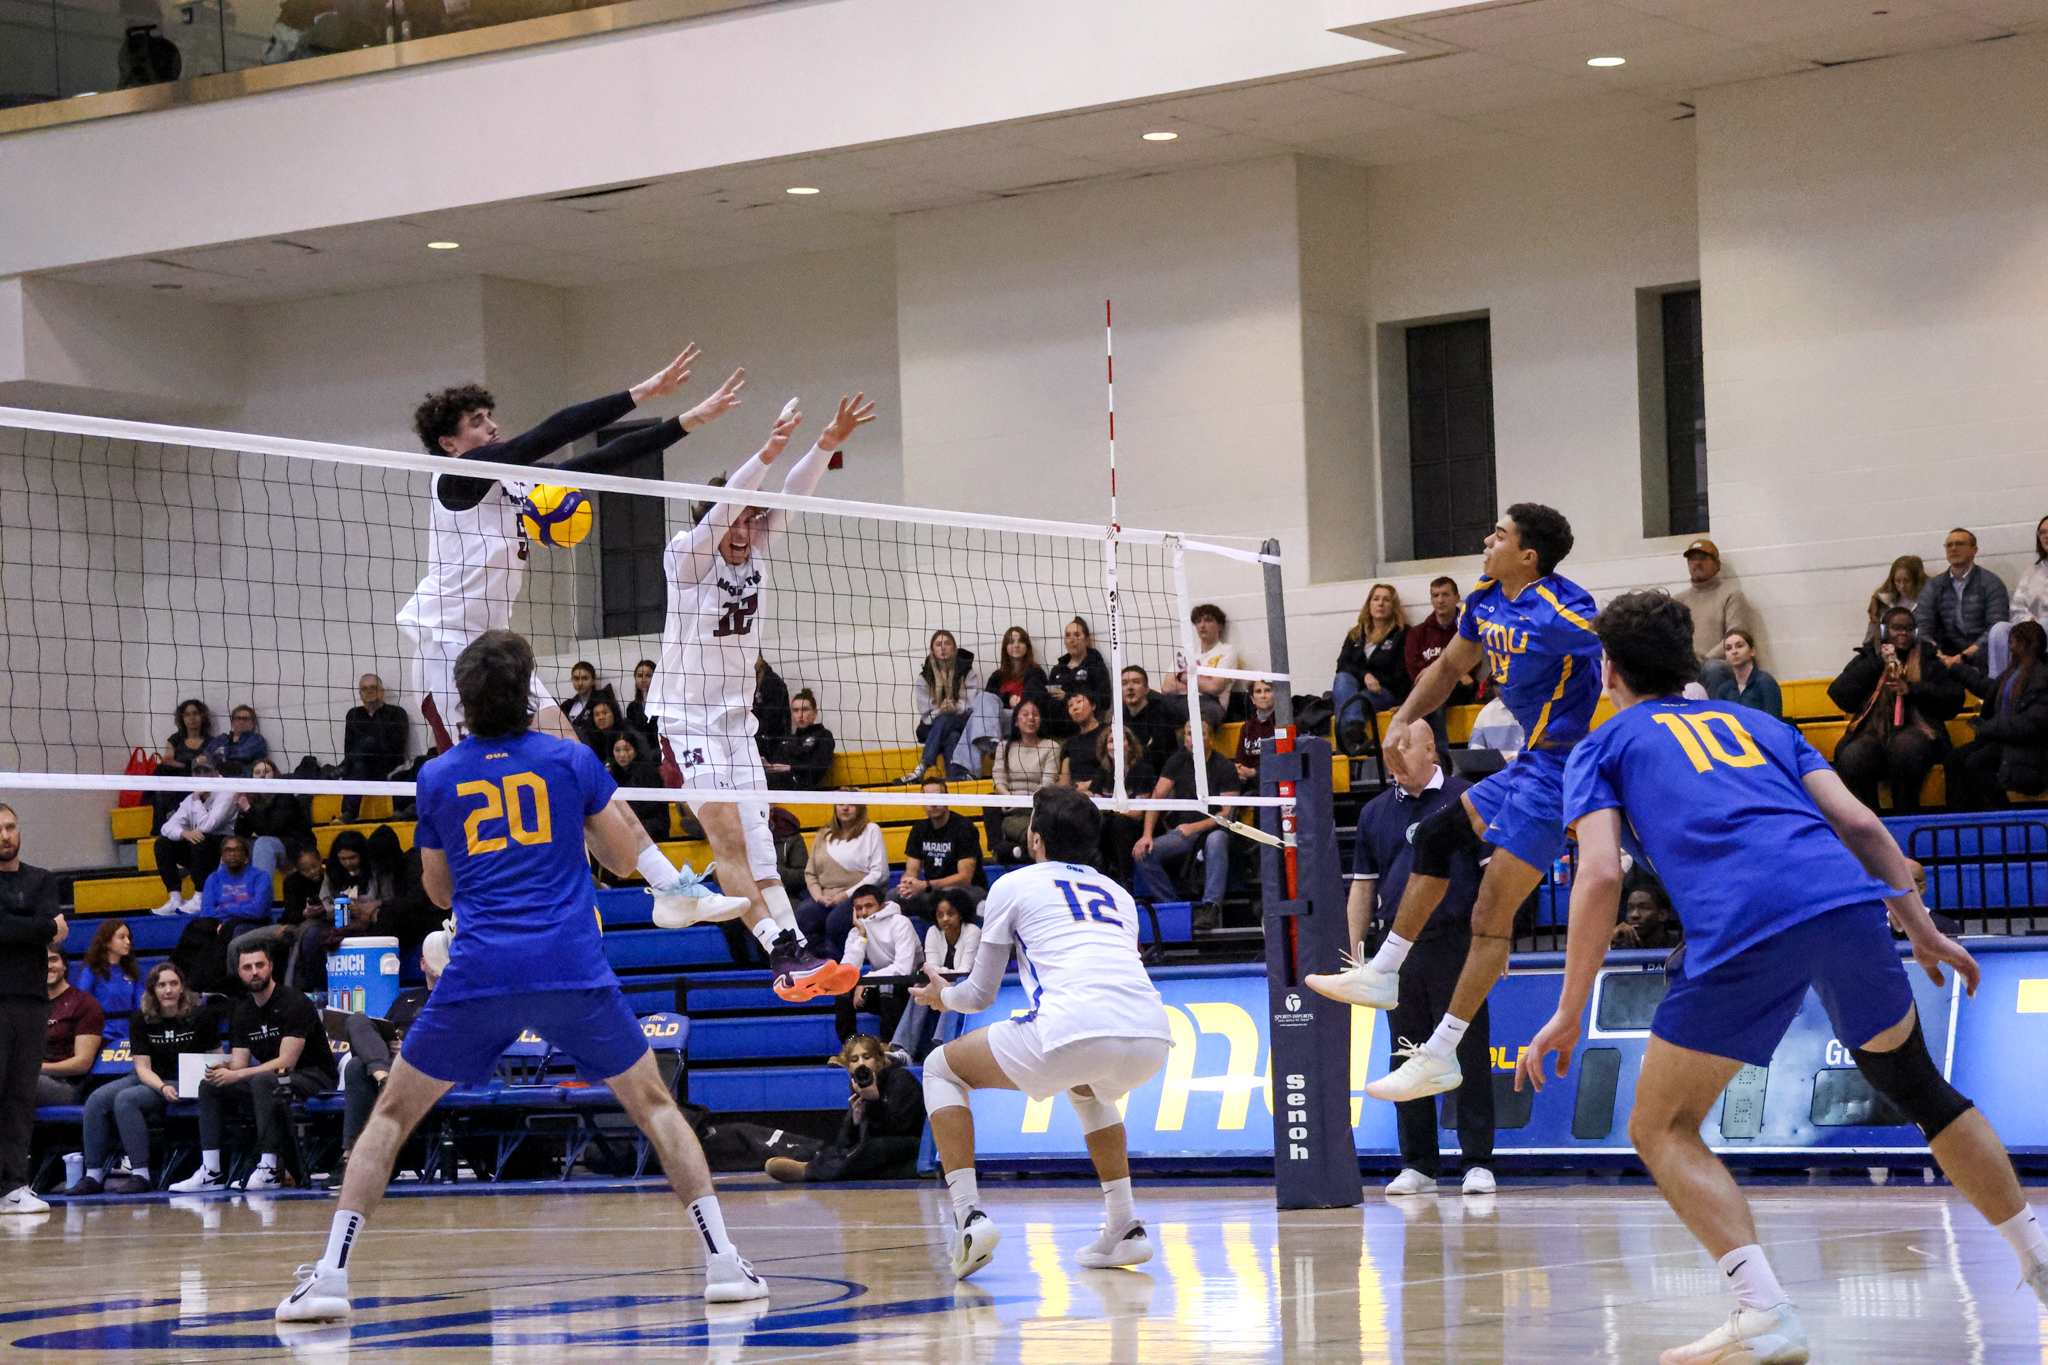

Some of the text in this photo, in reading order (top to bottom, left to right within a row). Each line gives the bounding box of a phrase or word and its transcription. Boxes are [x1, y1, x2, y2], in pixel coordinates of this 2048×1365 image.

[485, 752, 509, 760] OUA
[1651, 710, 1767, 774] 10
[456, 771, 552, 856] 20
[1052, 879, 1125, 930] 12
[640, 1022, 680, 1038] OLD
[101, 1049, 133, 1062] BOL
